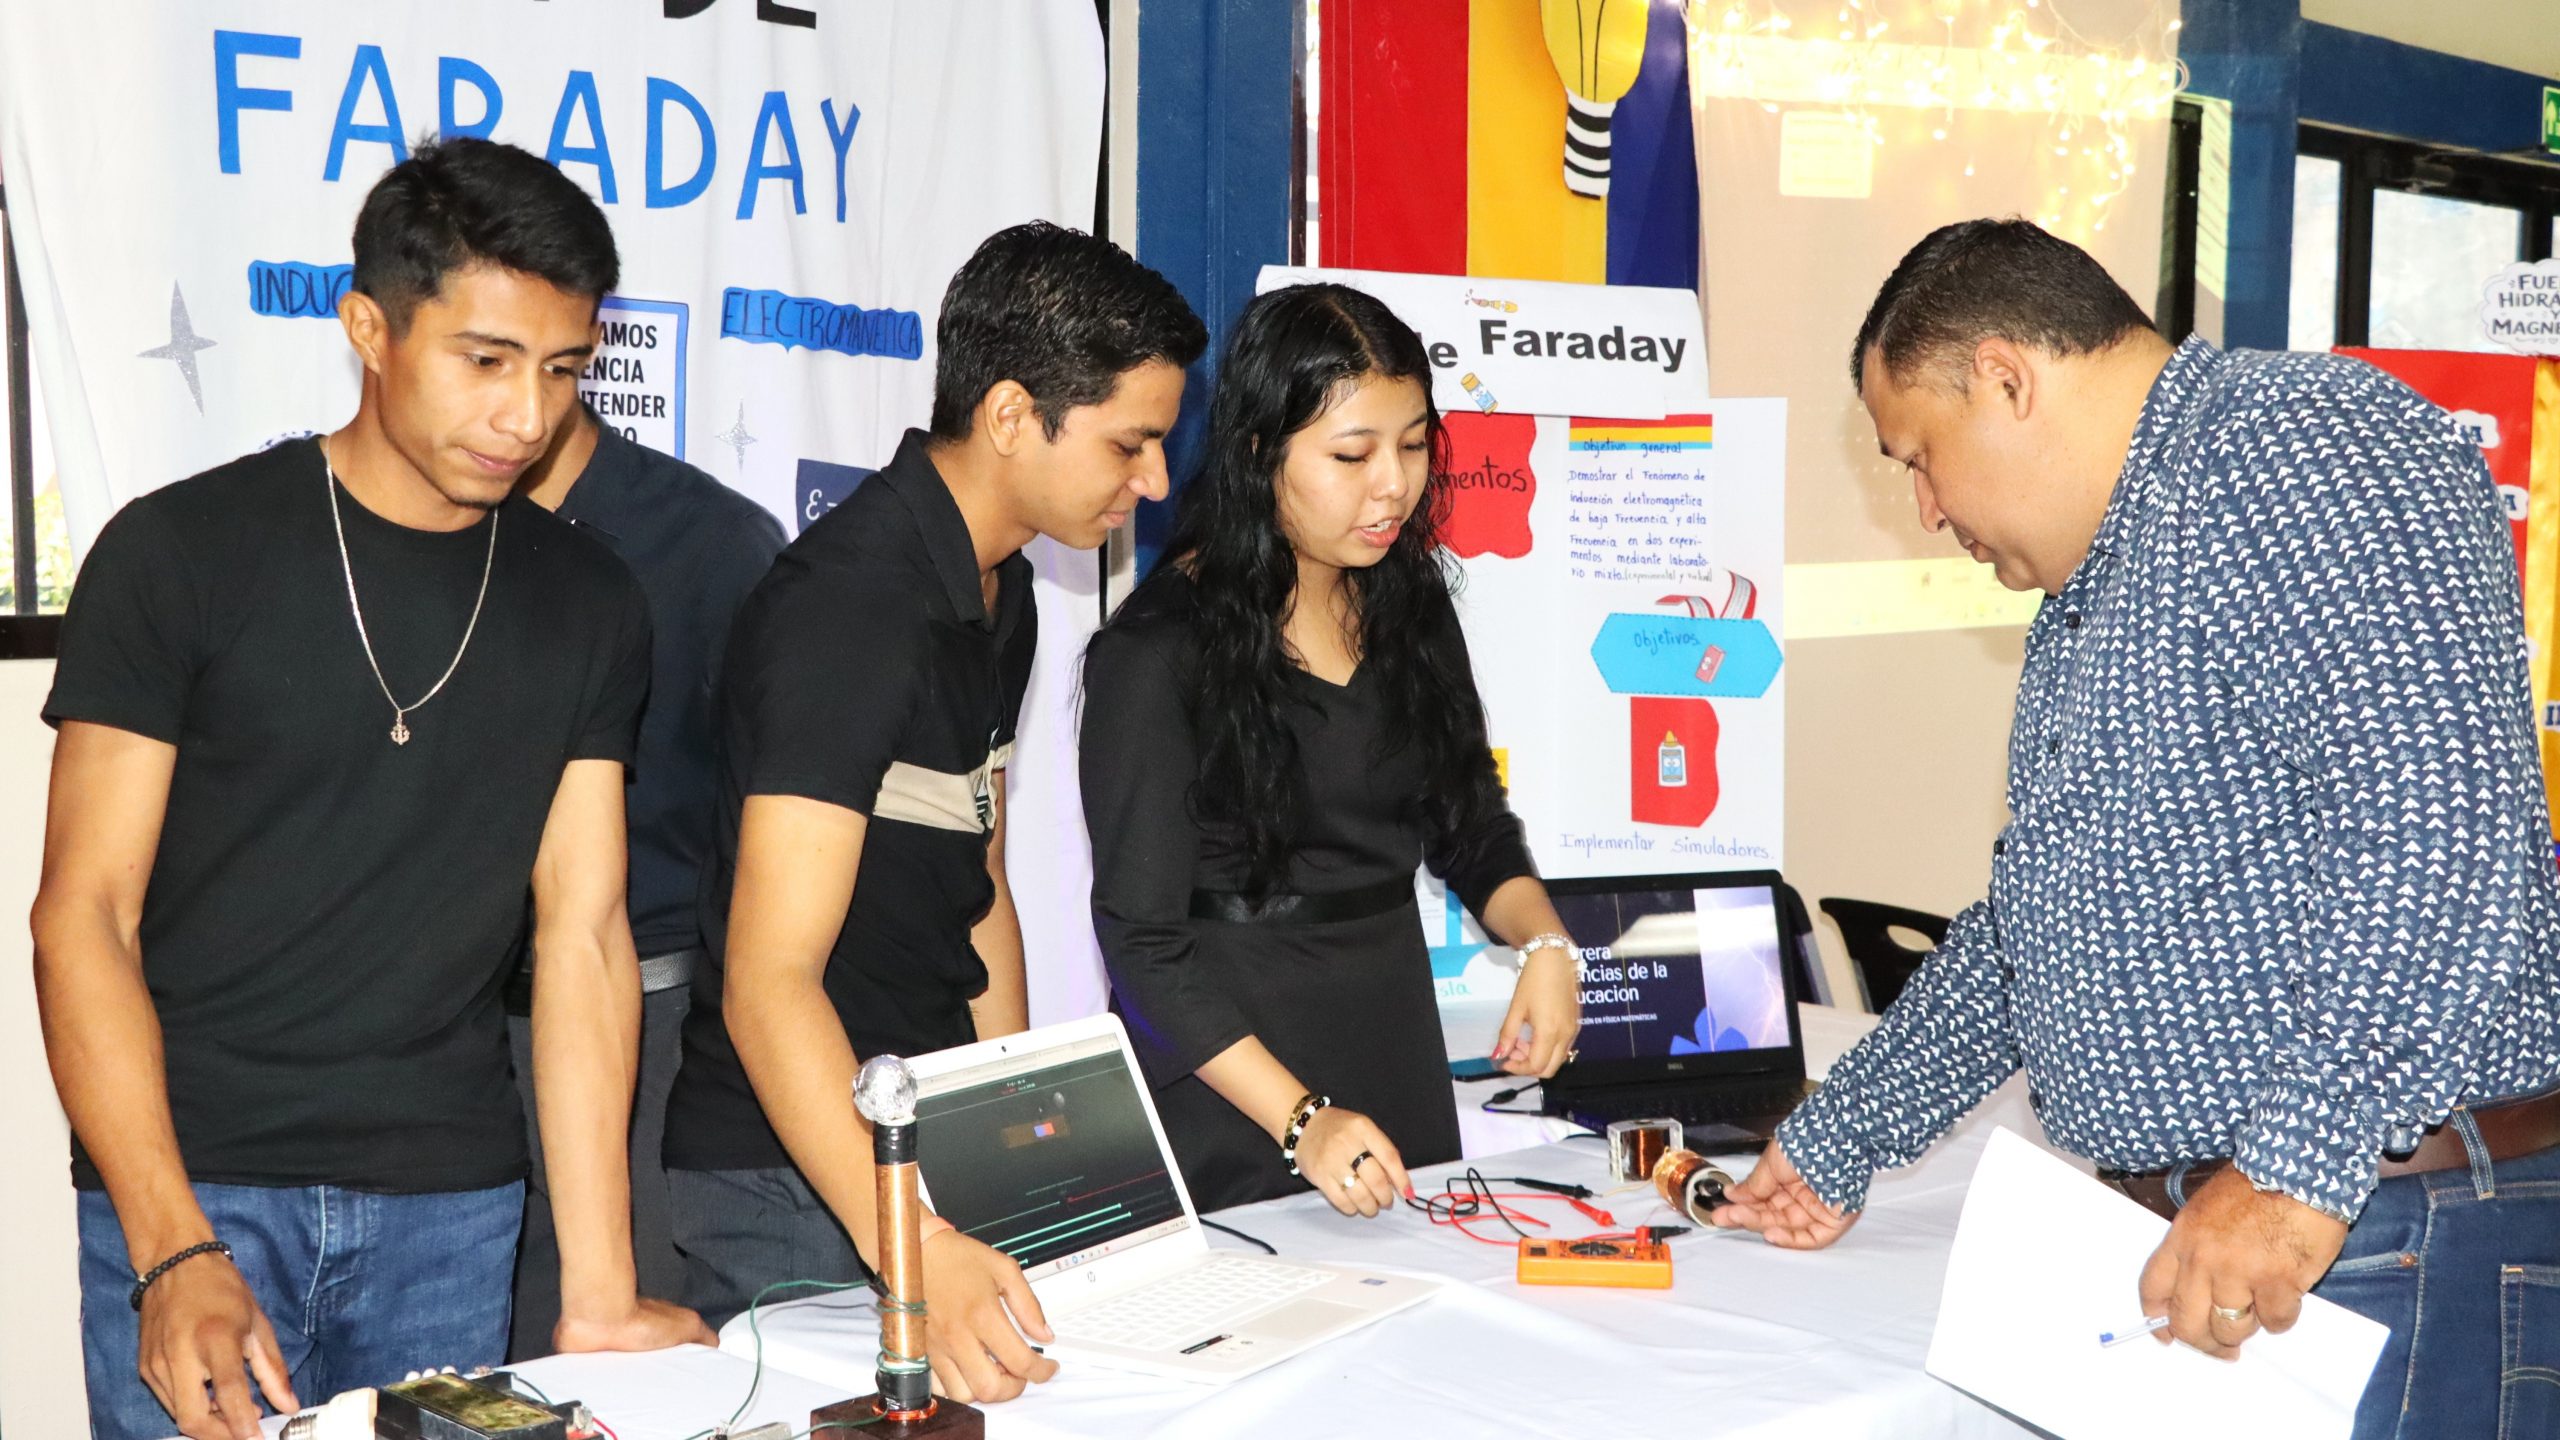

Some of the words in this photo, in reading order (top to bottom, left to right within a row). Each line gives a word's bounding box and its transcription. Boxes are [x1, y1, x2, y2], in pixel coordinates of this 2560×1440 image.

[1479, 319, 1687, 373] Faraday
[1641, 441, 1682, 458] general
[1569, 467, 1617, 482] Demostrar
[1625, 468, 1633, 480] el
[1693, 469, 1705, 481] de
[1569, 509, 1580, 522] de
[1588, 511, 1608, 530] baja
[1676, 516, 1681, 527] y
[1686, 512, 1707, 525] alta
[1628, 537, 1638, 546] en
[1645, 532, 1663, 546] dos
[1570, 549, 1602, 562] mentos
[1616, 551, 1662, 565] mediante
[1571, 567, 1585, 578] rio
[1559, 831, 1656, 859] Implementar
[1628, 962, 1649, 980] de
[1653, 960, 1668, 979] la
